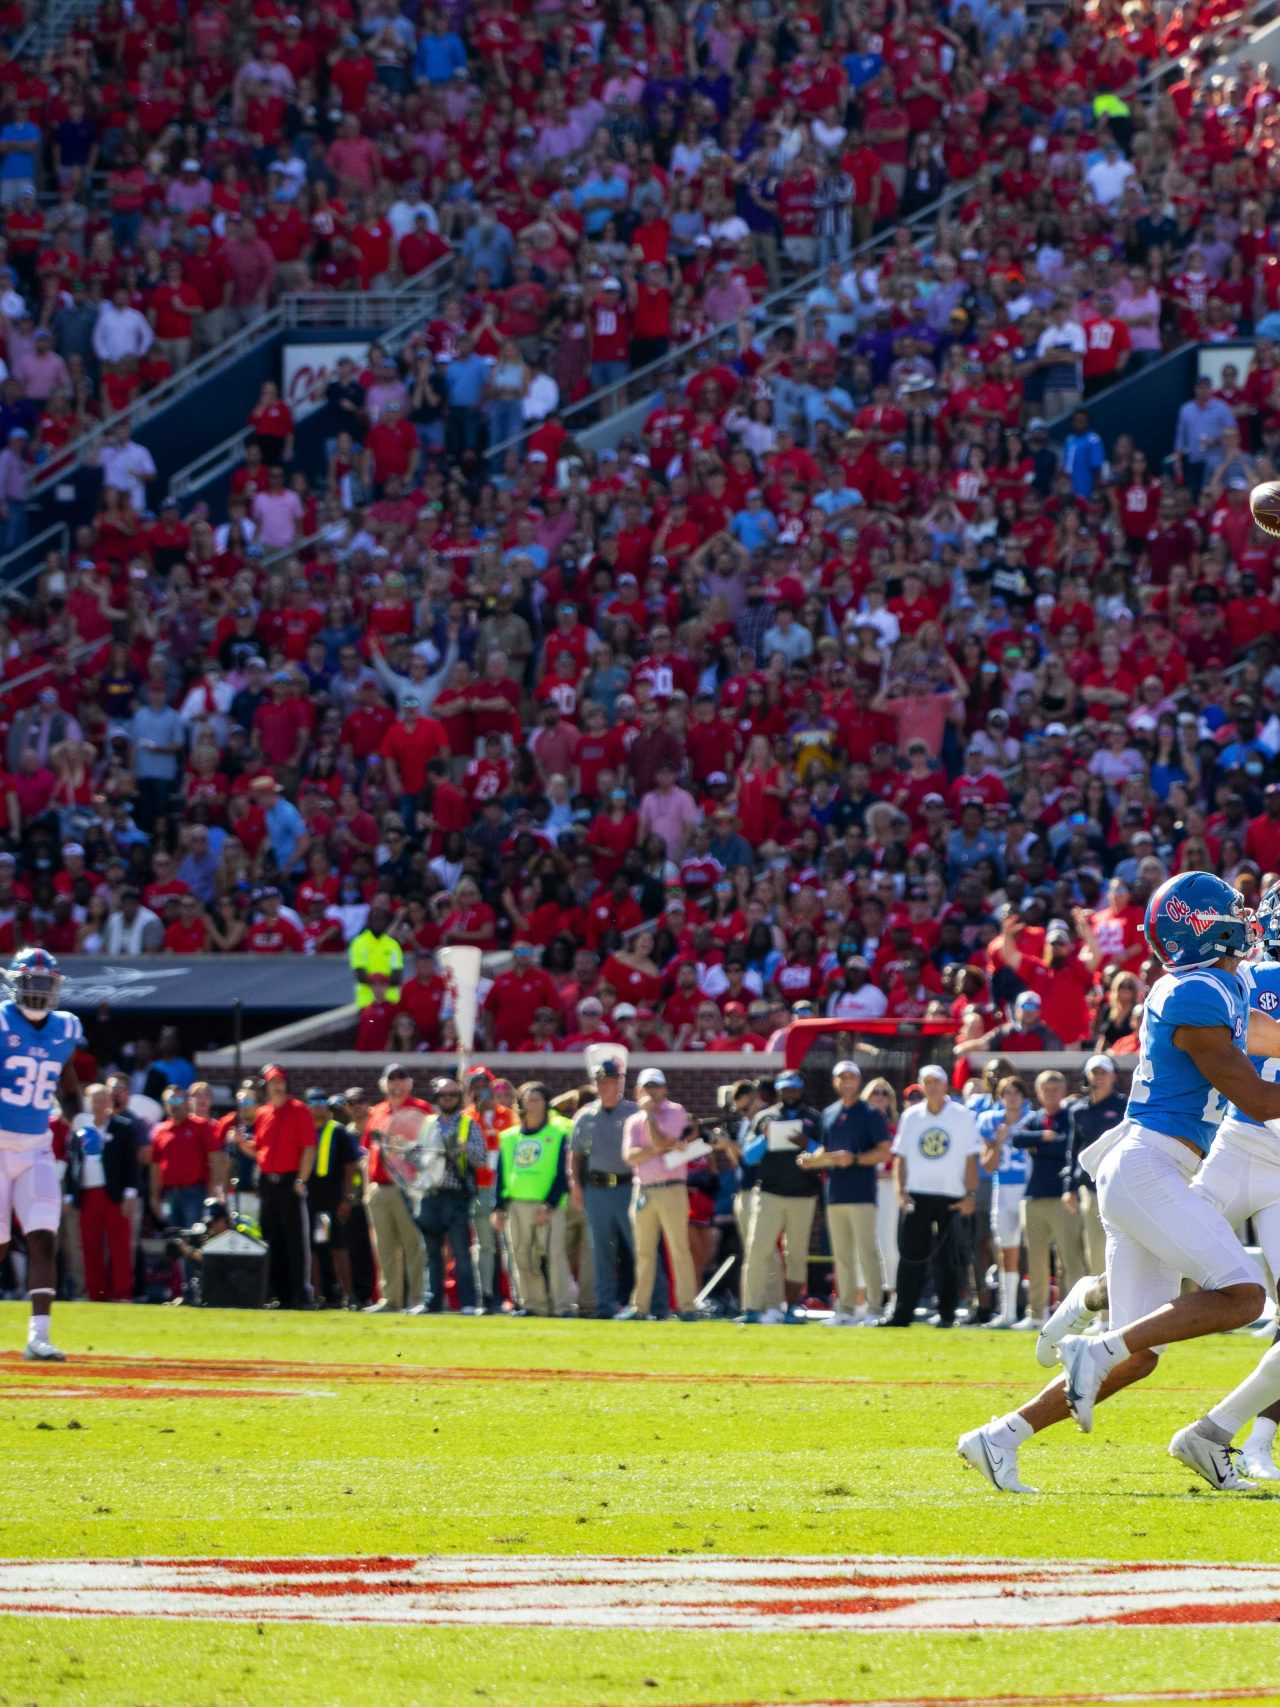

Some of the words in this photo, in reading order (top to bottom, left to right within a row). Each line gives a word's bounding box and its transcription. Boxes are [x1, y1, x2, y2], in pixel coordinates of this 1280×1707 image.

[1166, 896, 1191, 922] Ole
[1260, 992, 1278, 1010] SEC
[1, 1055, 63, 1110] 36
